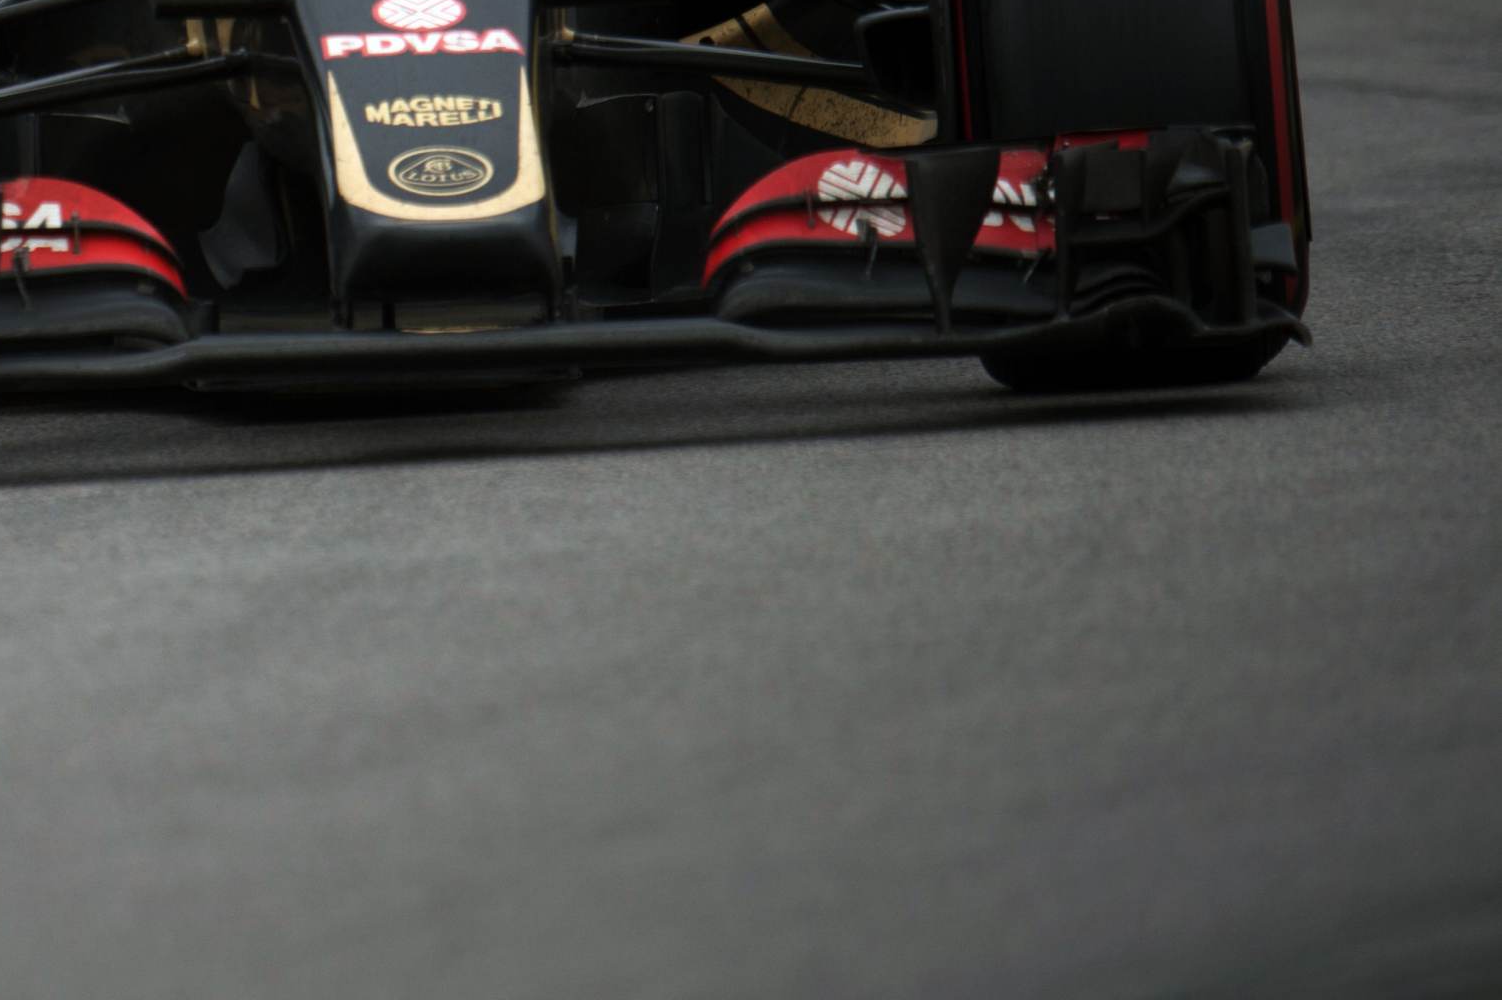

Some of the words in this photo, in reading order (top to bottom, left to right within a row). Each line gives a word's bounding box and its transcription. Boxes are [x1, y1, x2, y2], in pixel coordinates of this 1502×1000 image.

[322, 28, 526, 59] PDVSA
[364, 96, 502, 119] MAGNETI
[364, 105, 502, 127] MARELLI
[406, 168, 479, 183] LOTUS
